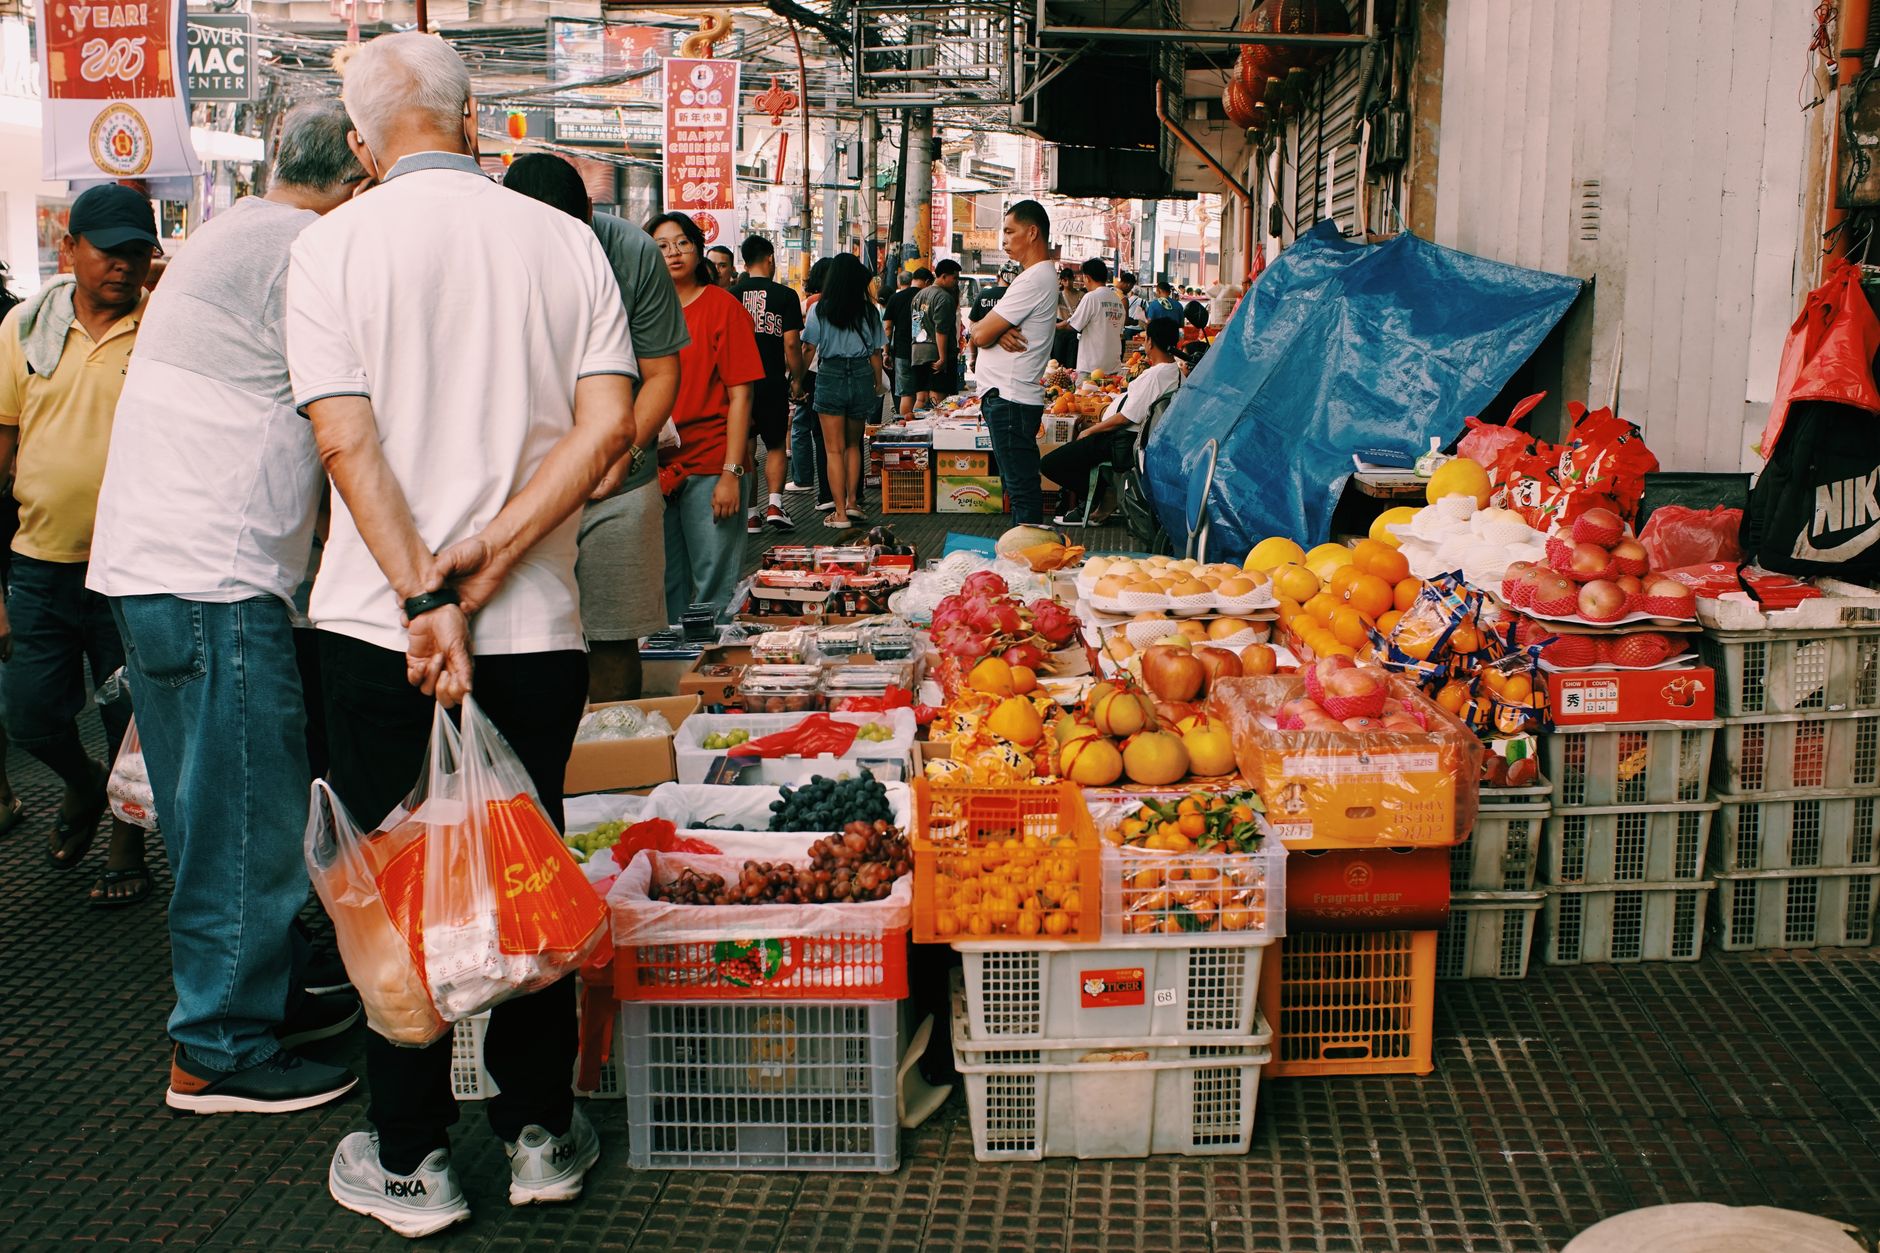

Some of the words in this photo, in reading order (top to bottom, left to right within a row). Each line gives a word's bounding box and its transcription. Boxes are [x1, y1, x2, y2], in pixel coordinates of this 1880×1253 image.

[69, 3, 148, 28] YEAR!
[187, 27, 244, 45] OWER
[188, 76, 245, 90] ENTER
[678, 111, 724, 124] 新年快樂
[677, 131, 725, 141] HAPPY
[668, 142, 730, 153] CHINESE
[685, 155, 717, 166] NEW
[677, 167, 720, 178] YEAR!
[742, 289, 767, 312] HIS
[981, 298, 998, 308] Cali
[754, 310, 783, 337] ESS
[1567, 693, 1580, 708] 秀
[1392, 813, 1445, 824] FRESH
[1313, 892, 1369, 905] Fragrant
[1373, 891, 1403, 903] pear
[1106, 981, 1140, 992] TIGER
[1157, 991, 1173, 1003] 68
[384, 1179, 427, 1197] HOKA
